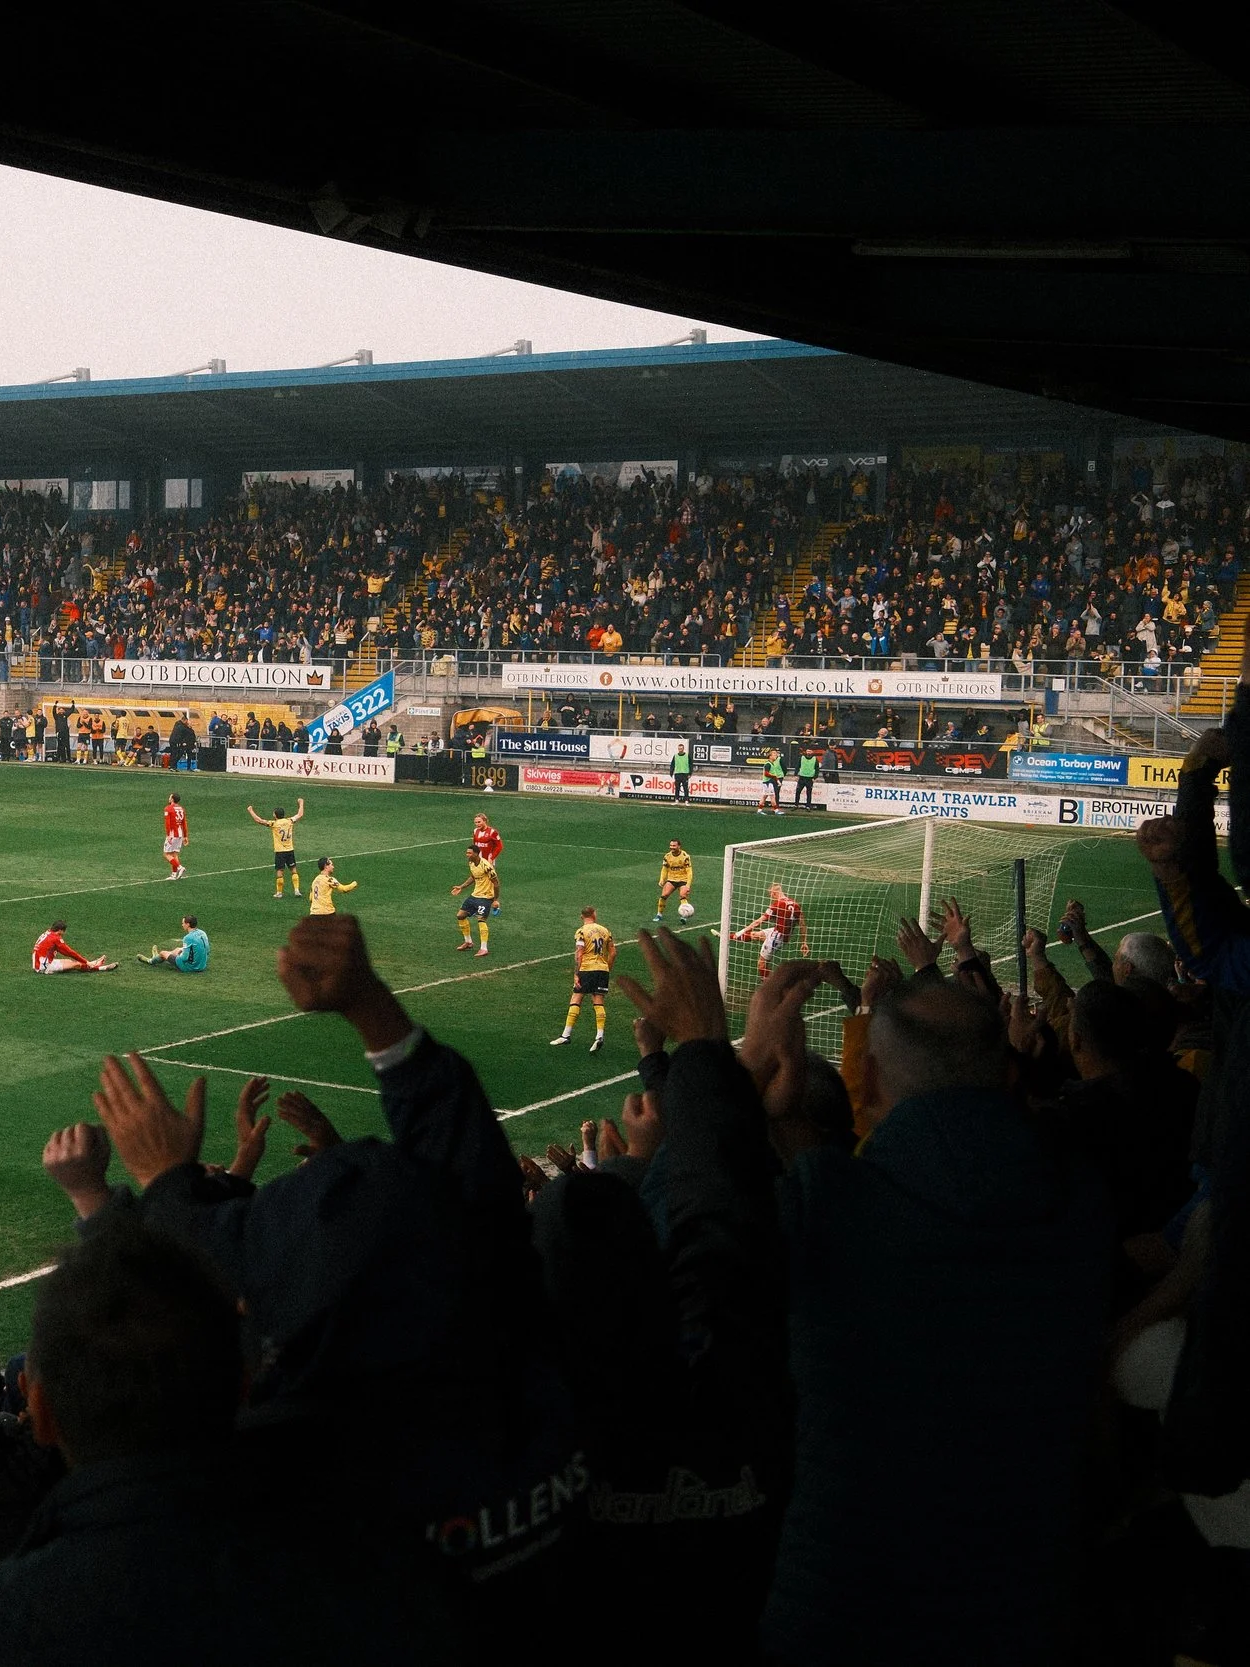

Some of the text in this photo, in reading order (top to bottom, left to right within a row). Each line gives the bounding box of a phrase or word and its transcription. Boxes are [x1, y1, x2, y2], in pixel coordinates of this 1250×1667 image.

[131, 664, 302, 686] OTB DECORATION
[507, 673, 588, 685] OTB INTERIORS
[621, 673, 856, 694] www.otbinteriorsltd.co.uk
[896, 682, 996, 695] OTB INTERIORS
[351, 687, 390, 721] 322
[326, 712, 351, 730] TAXIS
[499, 738, 588, 754] The Still House
[632, 740, 670, 756] adsl
[232, 755, 390, 777] EMPEROR SECURITY
[876, 750, 926, 768] REV
[945, 753, 998, 770] REV
[1027, 756, 1122, 771] Ocean Torbay BMW
[526, 768, 562, 781] Skivvies
[875, 764, 912, 772] COMPS
[944, 767, 983, 775] COMPS
[470, 766, 507, 788] 1899
[525, 783, 543, 792] 01803
[689, 779, 720, 796] pitts
[726, 785, 750, 794] Longest
[864, 787, 1017, 808] BRIXHAM TRAWLER
[175, 809, 184, 821] 33
[909, 804, 969, 819] AGENTS
[1092, 813, 1137, 829] IRVINE
[426, 1449, 590, 1556] OLLENS
